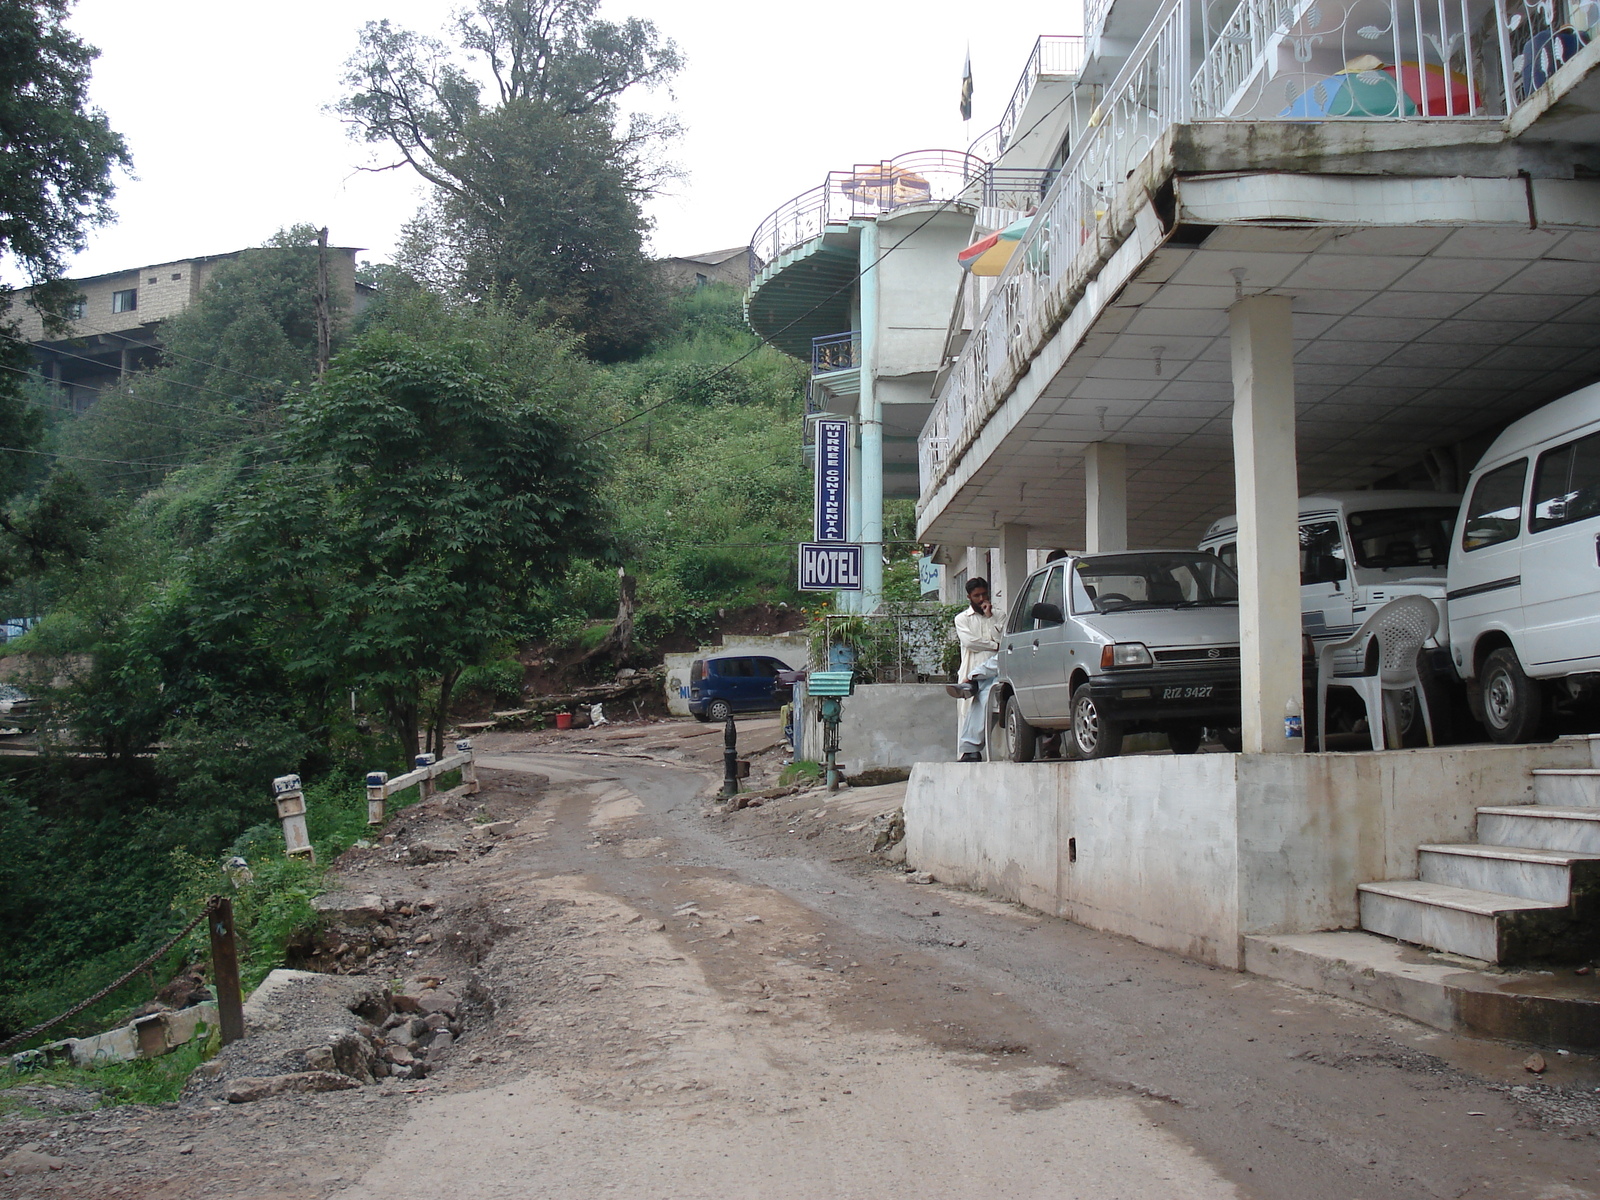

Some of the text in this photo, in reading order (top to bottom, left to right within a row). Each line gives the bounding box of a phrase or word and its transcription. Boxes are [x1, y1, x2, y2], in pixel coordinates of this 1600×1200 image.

[825, 424, 841, 540] MURREE CONTINENTAL
[805, 550, 858, 584] HOTEL
[1184, 686, 1213, 698] 3427
